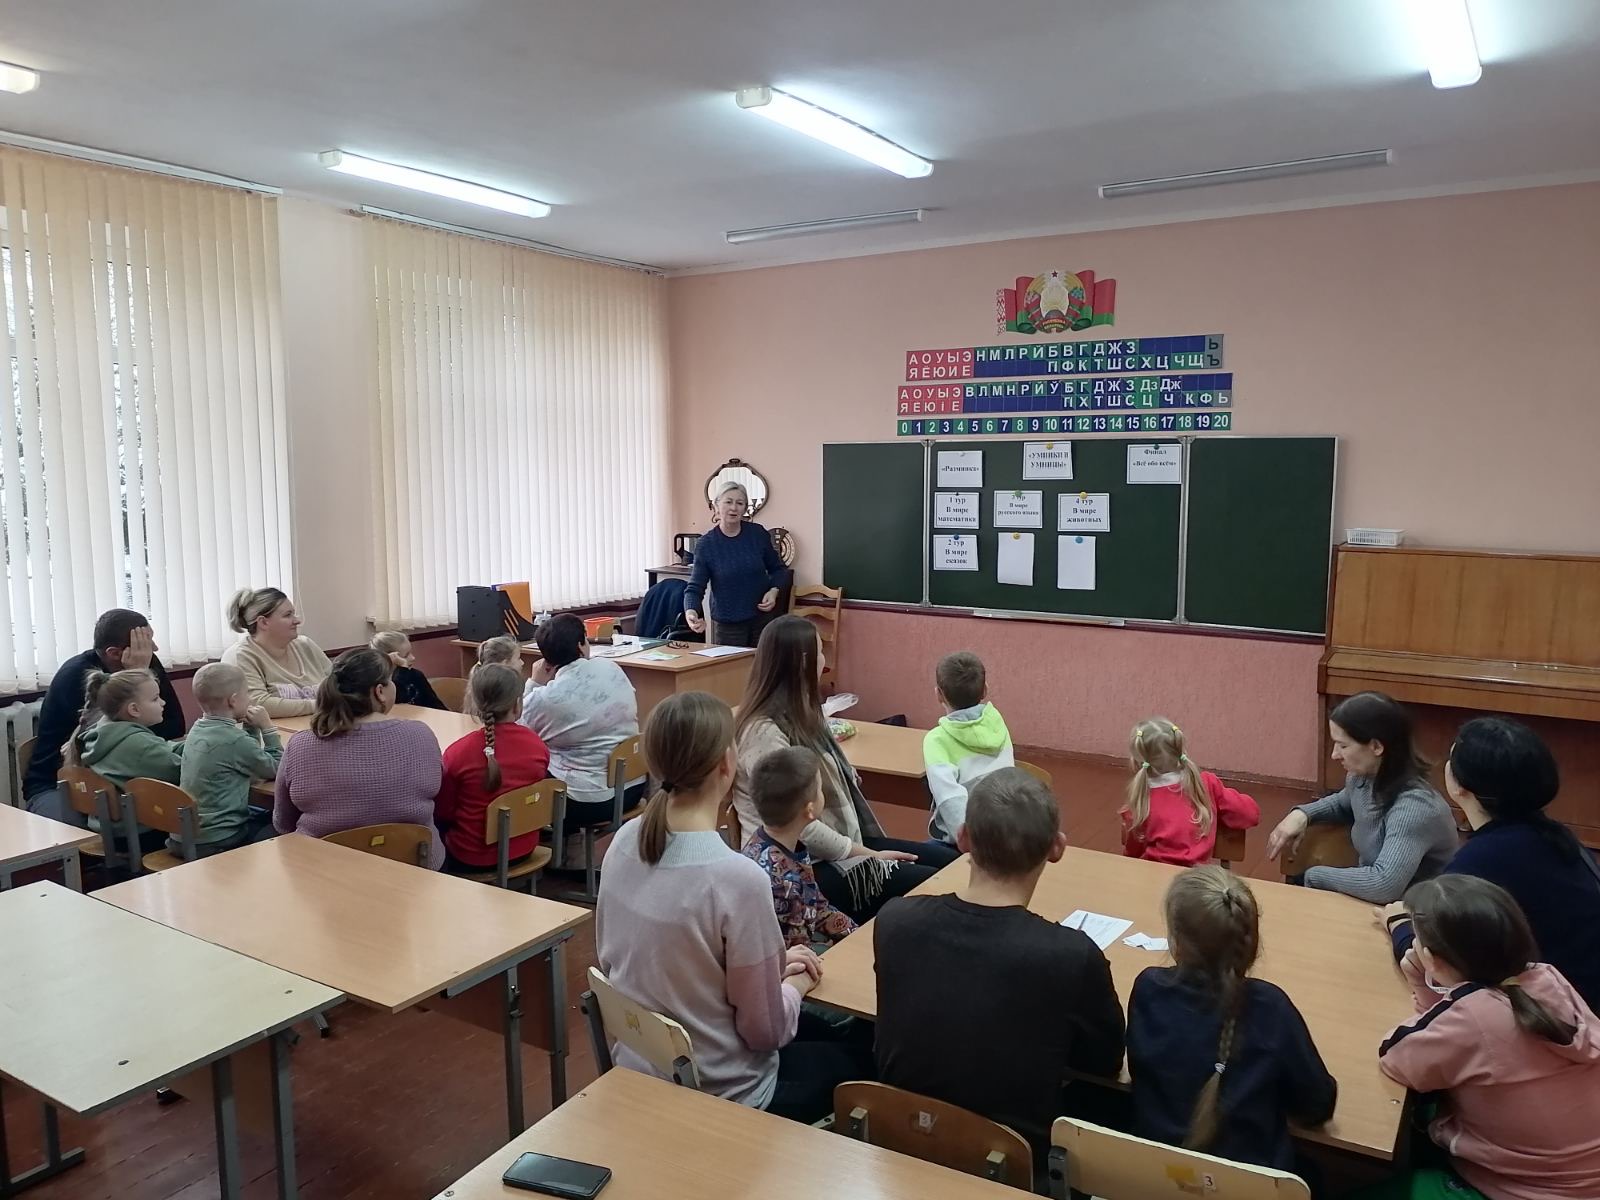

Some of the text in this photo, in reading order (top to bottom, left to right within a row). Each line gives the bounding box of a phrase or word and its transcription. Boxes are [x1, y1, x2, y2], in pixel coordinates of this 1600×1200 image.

[909, 338, 1218, 365] А О У Ы Э Н М Л Р Й Б В Г Д Ж З Ь
[909, 354, 1220, 378] Я Ё Ю И Е П Ф К Т Ш С Х Ц Ч Щ Ъ
[900, 378, 1181, 399] А О У Ы Э В Л М Н Р Й Ў Б Г Д Ж З Дз Дж
[900, 403, 908, 413] Я
[924, 402, 935, 412] Ю
[952, 401, 959, 411] Е
[1064, 396, 1073, 407] П
[1079, 396, 1088, 407] Х
[1095, 396, 1103, 407] Т
[1108, 395, 1120, 406] Ш
[1126, 395, 1135, 406] С
[1143, 394, 1152, 407] Ц
[1165, 394, 1174, 404] Ч
[1186, 394, 1194, 404] К
[1200, 393, 1212, 404] Ф
[1219, 392, 1228, 403] Ь
[902, 415, 1228, 433] 0 1 2 3 4 5 6 7 8 9 10 11 12 13 14 15 16 17 18 19 20
[1205, 1175, 1213, 1186] 3
